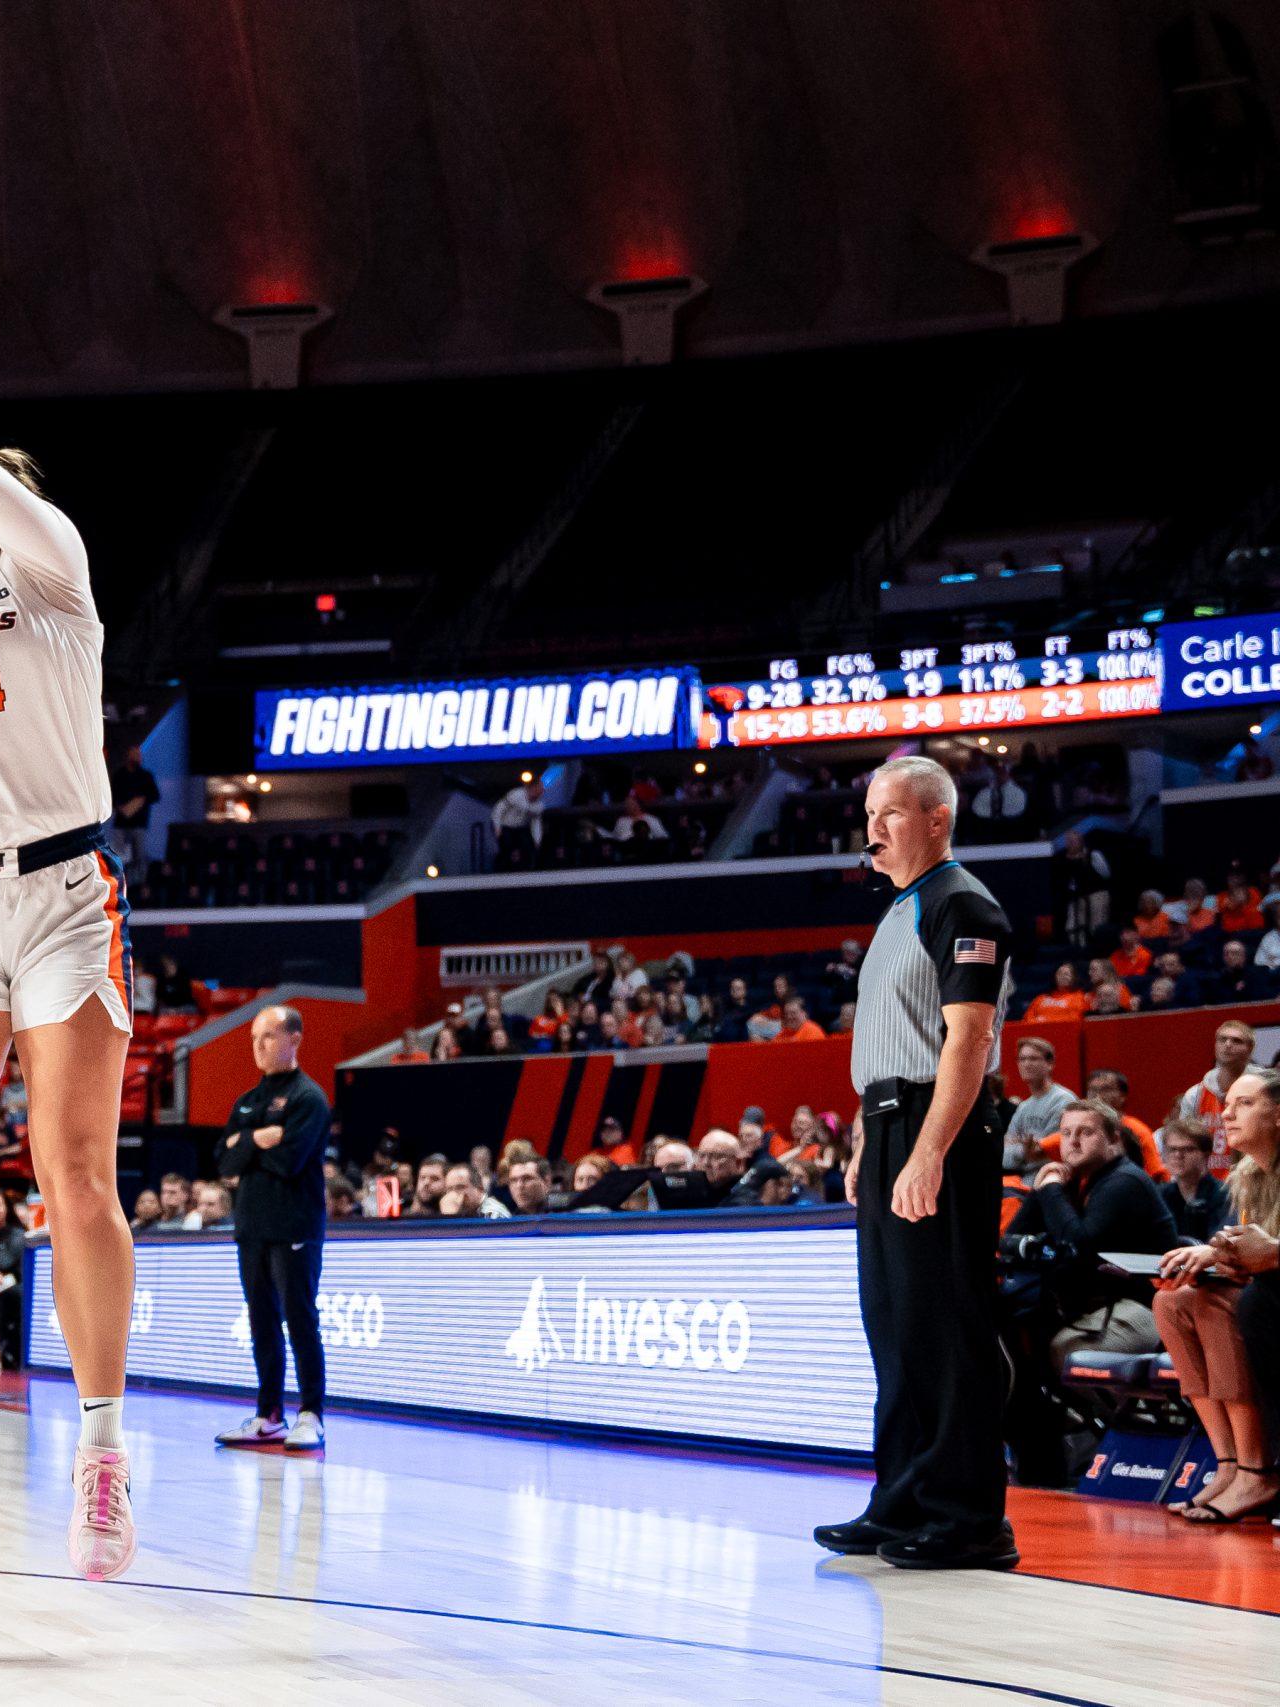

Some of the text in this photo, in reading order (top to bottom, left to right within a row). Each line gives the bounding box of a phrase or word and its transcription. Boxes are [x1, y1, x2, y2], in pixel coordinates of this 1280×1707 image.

[769, 627, 1151, 680] FG FG% 3PT 3PT% FT FT%
[1181, 630, 1264, 665] Carle
[747, 649, 1160, 710] 9-28 32.1% 1-9 11.1% 3-3 100.0%
[270, 676, 679, 756] FIGHTINGILLINI.COM
[744, 711, 808, 740] 15-28
[811, 705, 887, 736] 53.6%
[902, 701, 944, 730] 3-8
[959, 694, 1026, 726] 37.5%
[1040, 689, 1085, 718] 2-2
[315, 1292, 384, 1349] esco
[573, 1275, 751, 1373] Invesco
